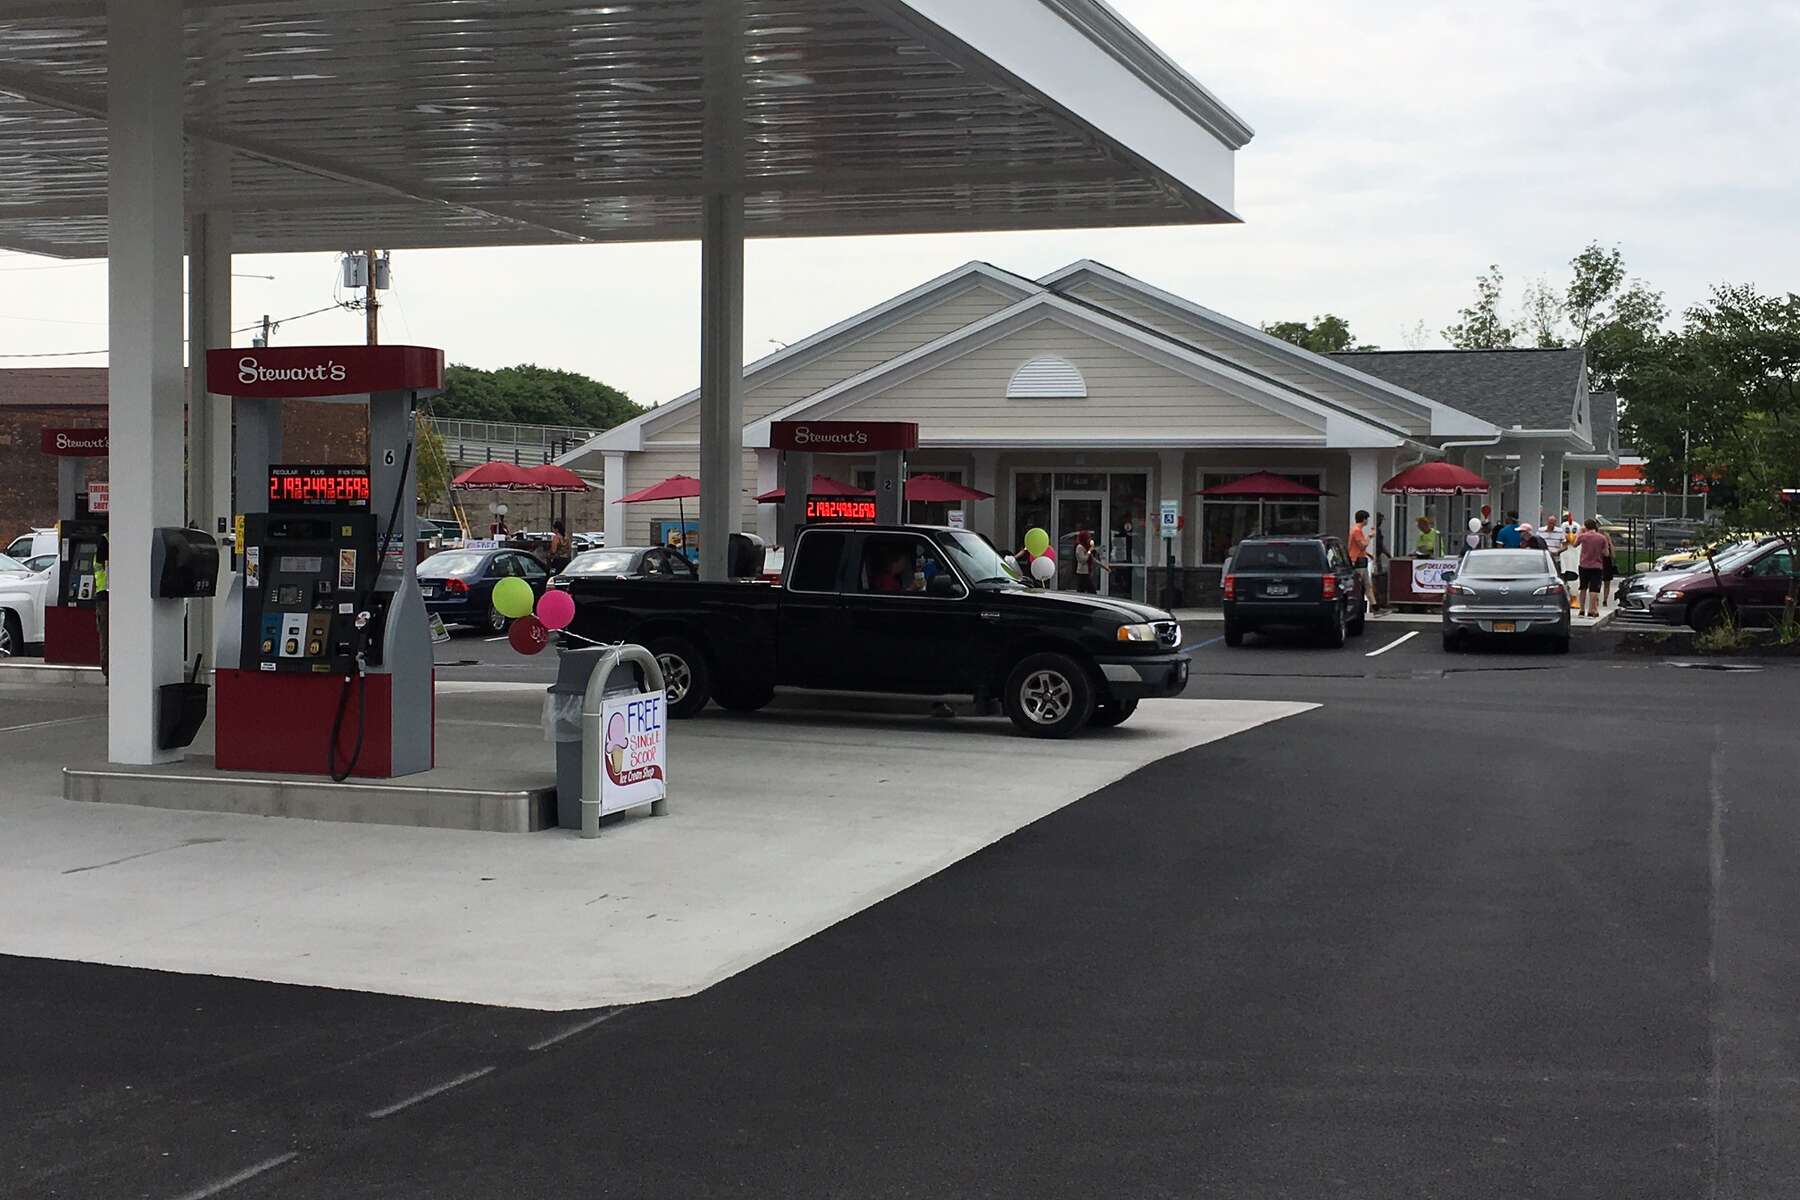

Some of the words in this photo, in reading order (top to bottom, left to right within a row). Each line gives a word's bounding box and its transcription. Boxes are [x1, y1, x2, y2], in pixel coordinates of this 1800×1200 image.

[238, 356, 346, 384] Stewart's
[794, 426, 868, 444] Stewart's
[385, 450, 393, 465] 6
[628, 697, 661, 733] FREE
[630, 731, 661, 752] SINGLE
[631, 746, 657, 768] SCOOP
